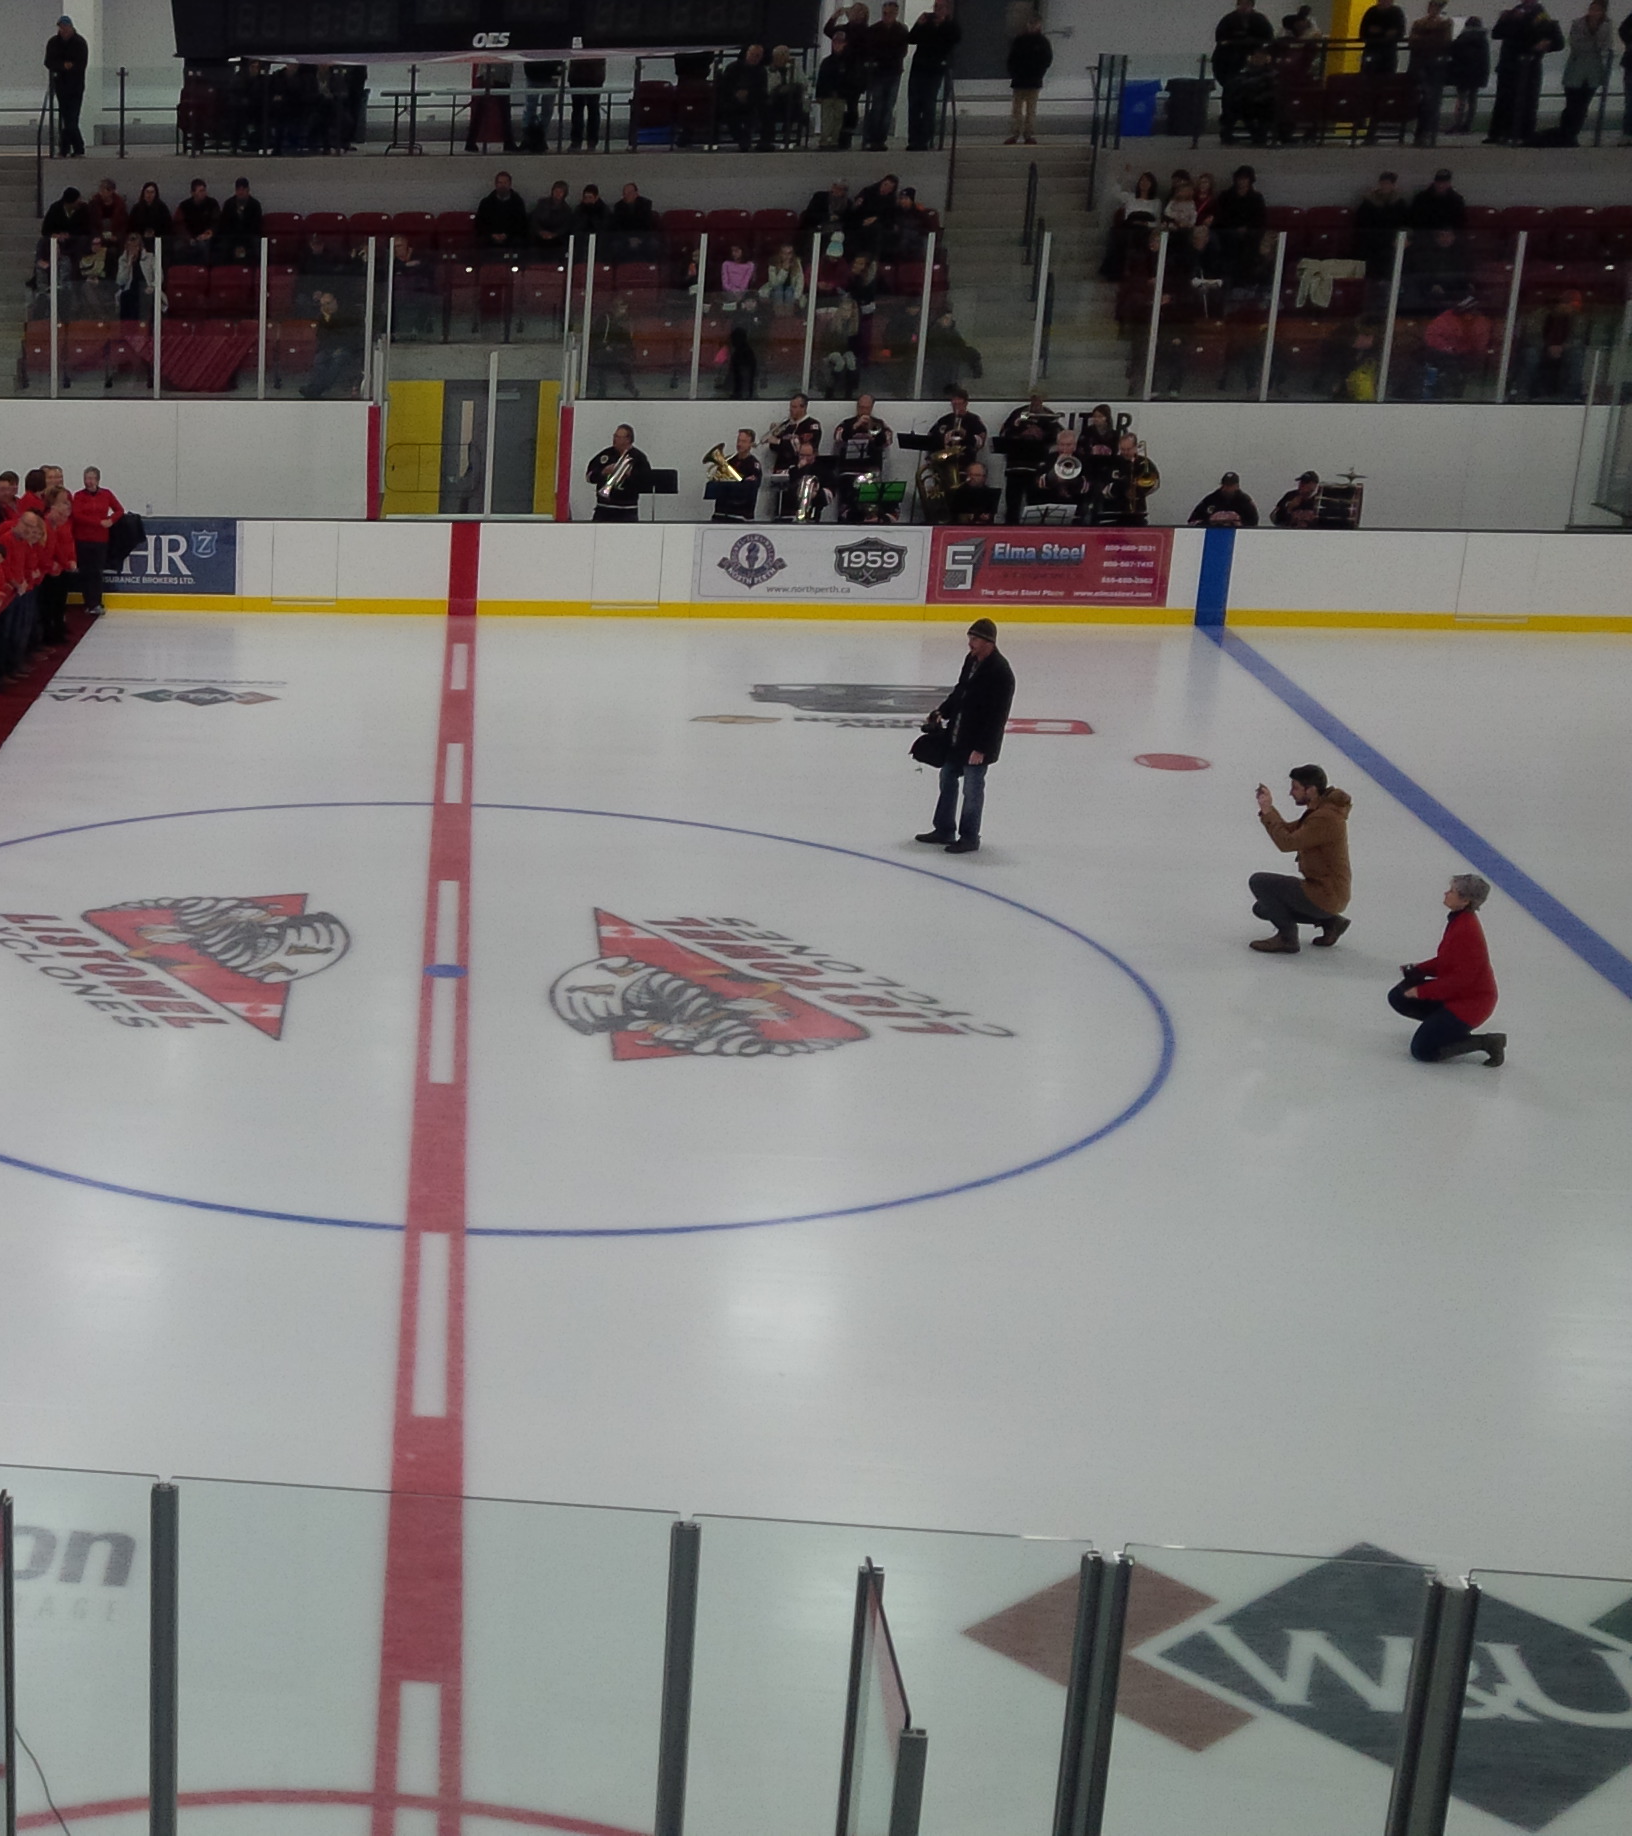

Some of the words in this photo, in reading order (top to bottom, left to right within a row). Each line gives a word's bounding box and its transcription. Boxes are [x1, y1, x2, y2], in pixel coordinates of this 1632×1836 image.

[472, 32, 510, 48] OES
[992, 543, 1036, 560] Elma
[1041, 543, 1085, 560] Steel
[841, 551, 899, 569] 1959
[102, 576, 140, 585] SURANCE
[141, 576, 178, 585] BROKERS
[179, 577, 196, 586] LTD.
[767, 584, 851, 595] www.northperth.ca
[44, 686, 125, 694] UP
[49, 694, 122, 704] WA
[0, 913, 230, 1029] LISTOWEL
[643, 917, 969, 1035] LISTOWEL
[707, 916, 1016, 1039] CYCLONES
